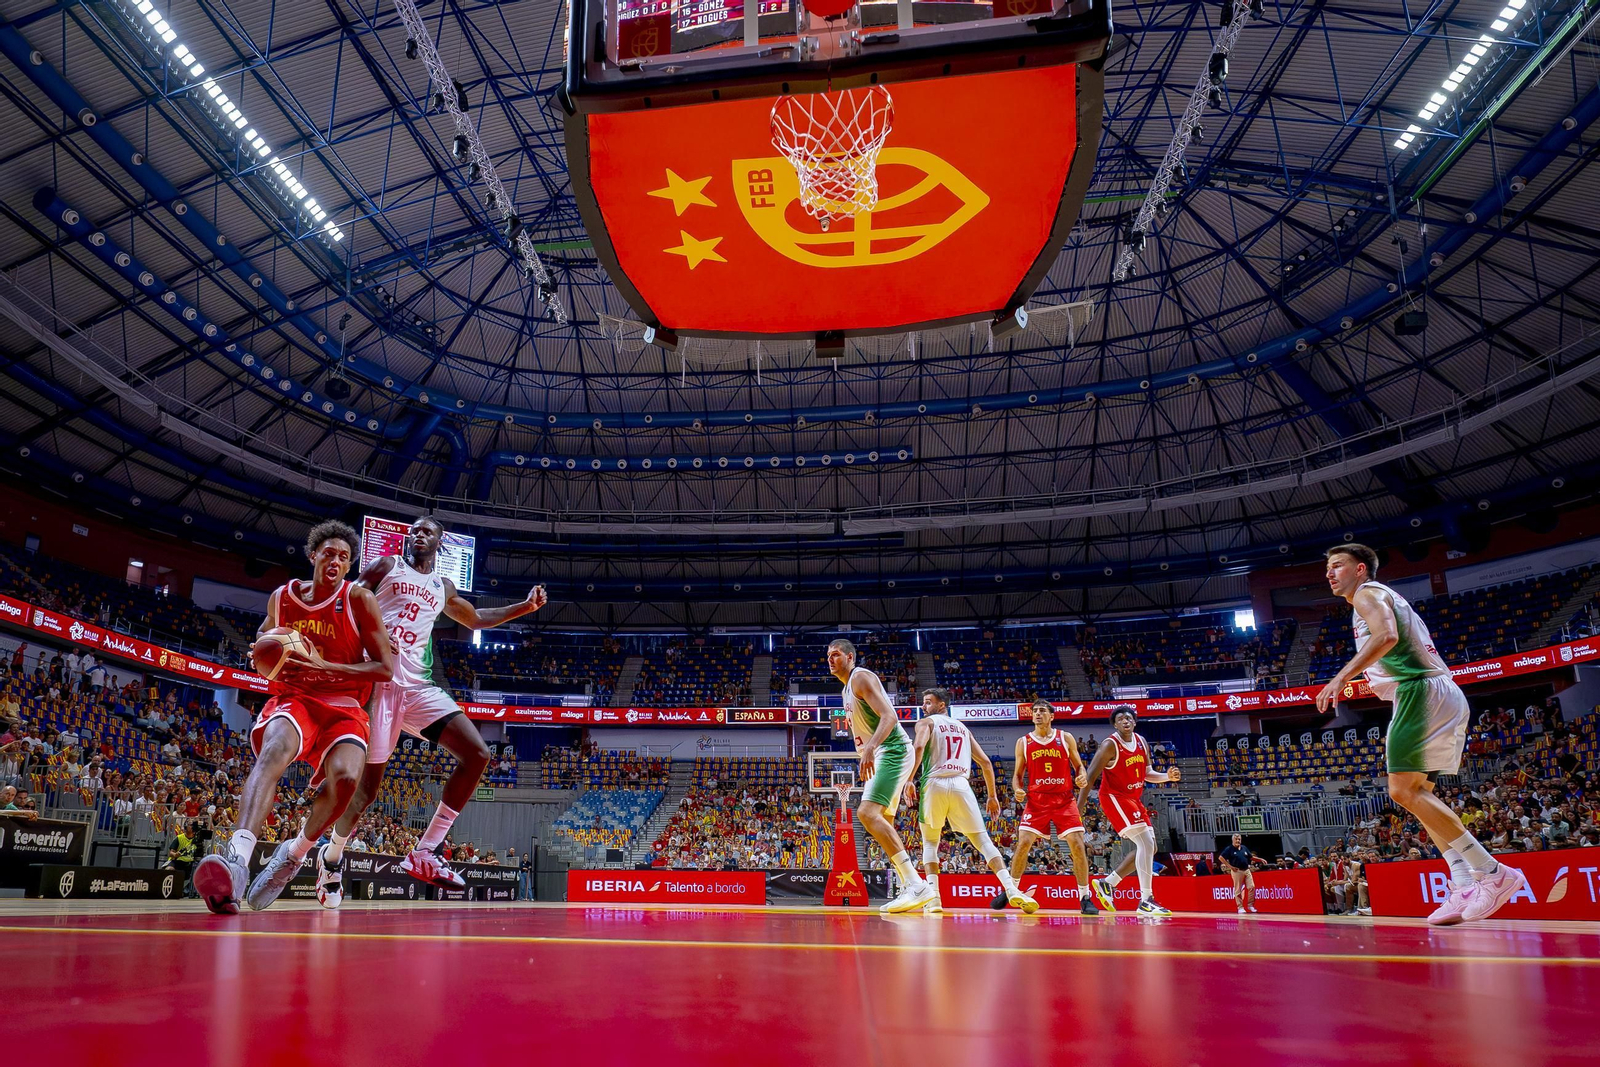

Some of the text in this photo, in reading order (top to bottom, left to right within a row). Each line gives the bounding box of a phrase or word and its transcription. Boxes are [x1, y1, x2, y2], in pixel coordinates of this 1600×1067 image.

[771, 3, 777, 11] 2
[748, 169, 775, 208] FEB
[0, 601, 21, 615] álaga
[103, 635, 137, 656] Andalucía
[188, 662, 214, 674] IBERIA
[1514, 656, 1546, 668] málaga
[1450, 662, 1502, 676] azulmarino
[232, 672, 269, 685] azulmarino
[1267, 691, 1312, 705] Andalucía
[468, 706, 495, 714] IBERIA
[515, 708, 553, 716] azulmarino
[965, 708, 1012, 717] PORTUGAL
[1147, 702, 1174, 711] málaga
[560, 711, 584, 719] málaga
[657, 711, 692, 721] Andalucía
[734, 709, 775, 720] ESPAÑA B
[796, 710, 810, 721] 18
[896, 708, 912, 720] 12
[834, 718, 849, 730] 11
[939, 725, 966, 736] DA SILVA
[945, 736, 963, 760] 17
[1031, 748, 1061, 760] ESPAÑA
[1044, 762, 1053, 773] 5
[1135, 768, 1139, 778] 1
[1035, 777, 1065, 785] endesa
[14, 829, 74, 853] tenerife!
[790, 873, 824, 883] endesa
[90, 879, 149, 893] #LaFamilia
[379, 886, 404, 896] #LaFamilia
[586, 880, 746, 894] IBERIA Talento a bordo
[952, 885, 1002, 897] IBERI
[1113, 887, 1142, 899] ordo
[1275, 884, 1294, 899] bordo
[831, 889, 862, 897] CaixaBank
